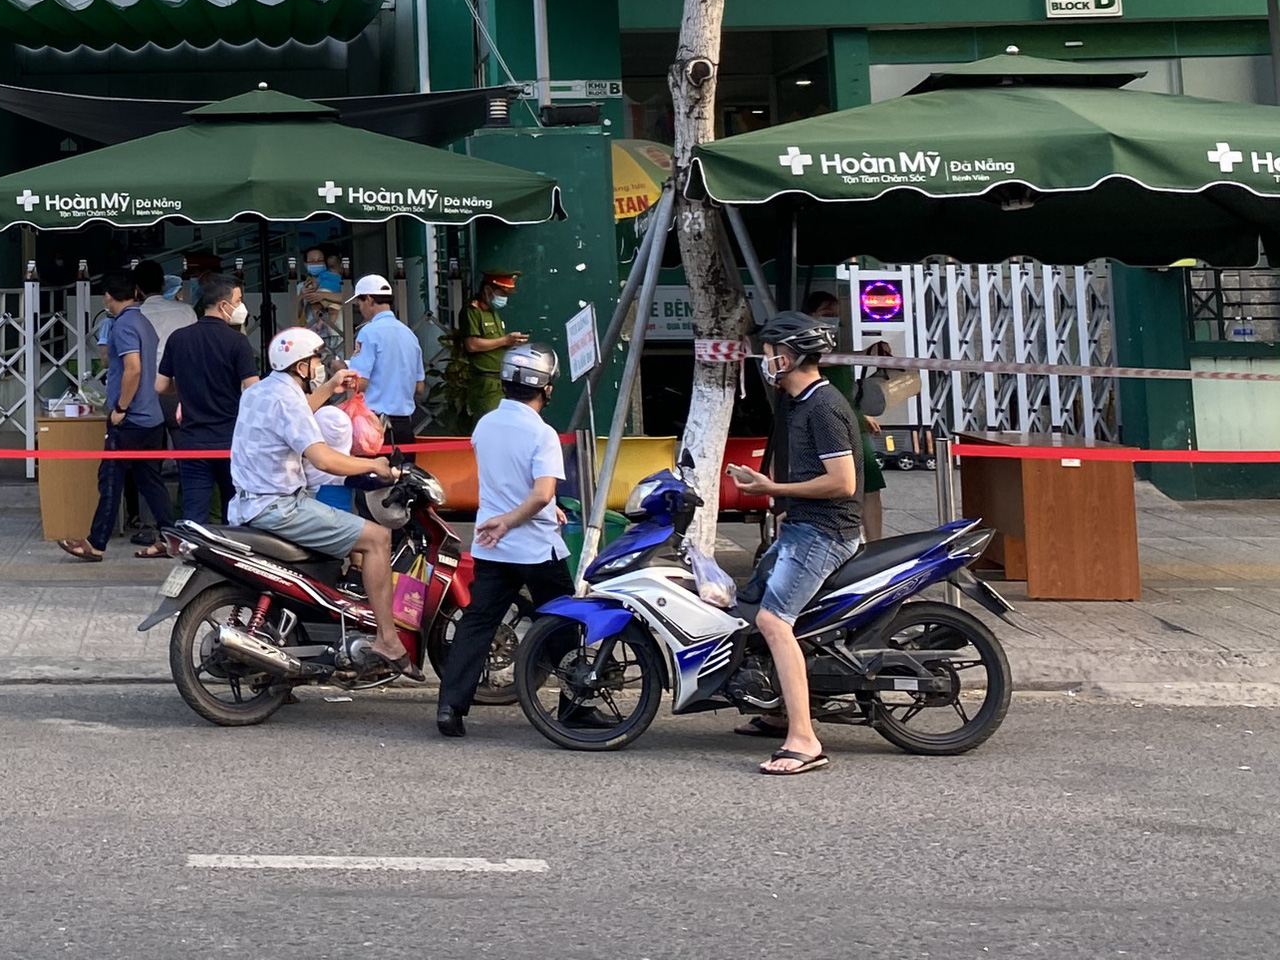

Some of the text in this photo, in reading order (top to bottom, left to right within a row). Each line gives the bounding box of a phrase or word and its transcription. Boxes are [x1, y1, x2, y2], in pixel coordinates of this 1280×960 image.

[1051, 1, 1090, 11] BLOCK
[609, 82, 621, 95] B
[820, 150, 941, 176] Hoàn Mỹ
[950, 160, 971, 172] Đà
[842, 175, 859, 184] Tận
[860, 174, 880, 183] Tâm
[909, 173, 926, 182] Sóc
[45, 192, 130, 212] Hoàn Mỹ
[136, 199, 150, 209] Đà
[348, 187, 439, 209] Hoàn Mỹ
[444, 197, 460, 207] Đà
[664, 298, 694, 321] BỆN
